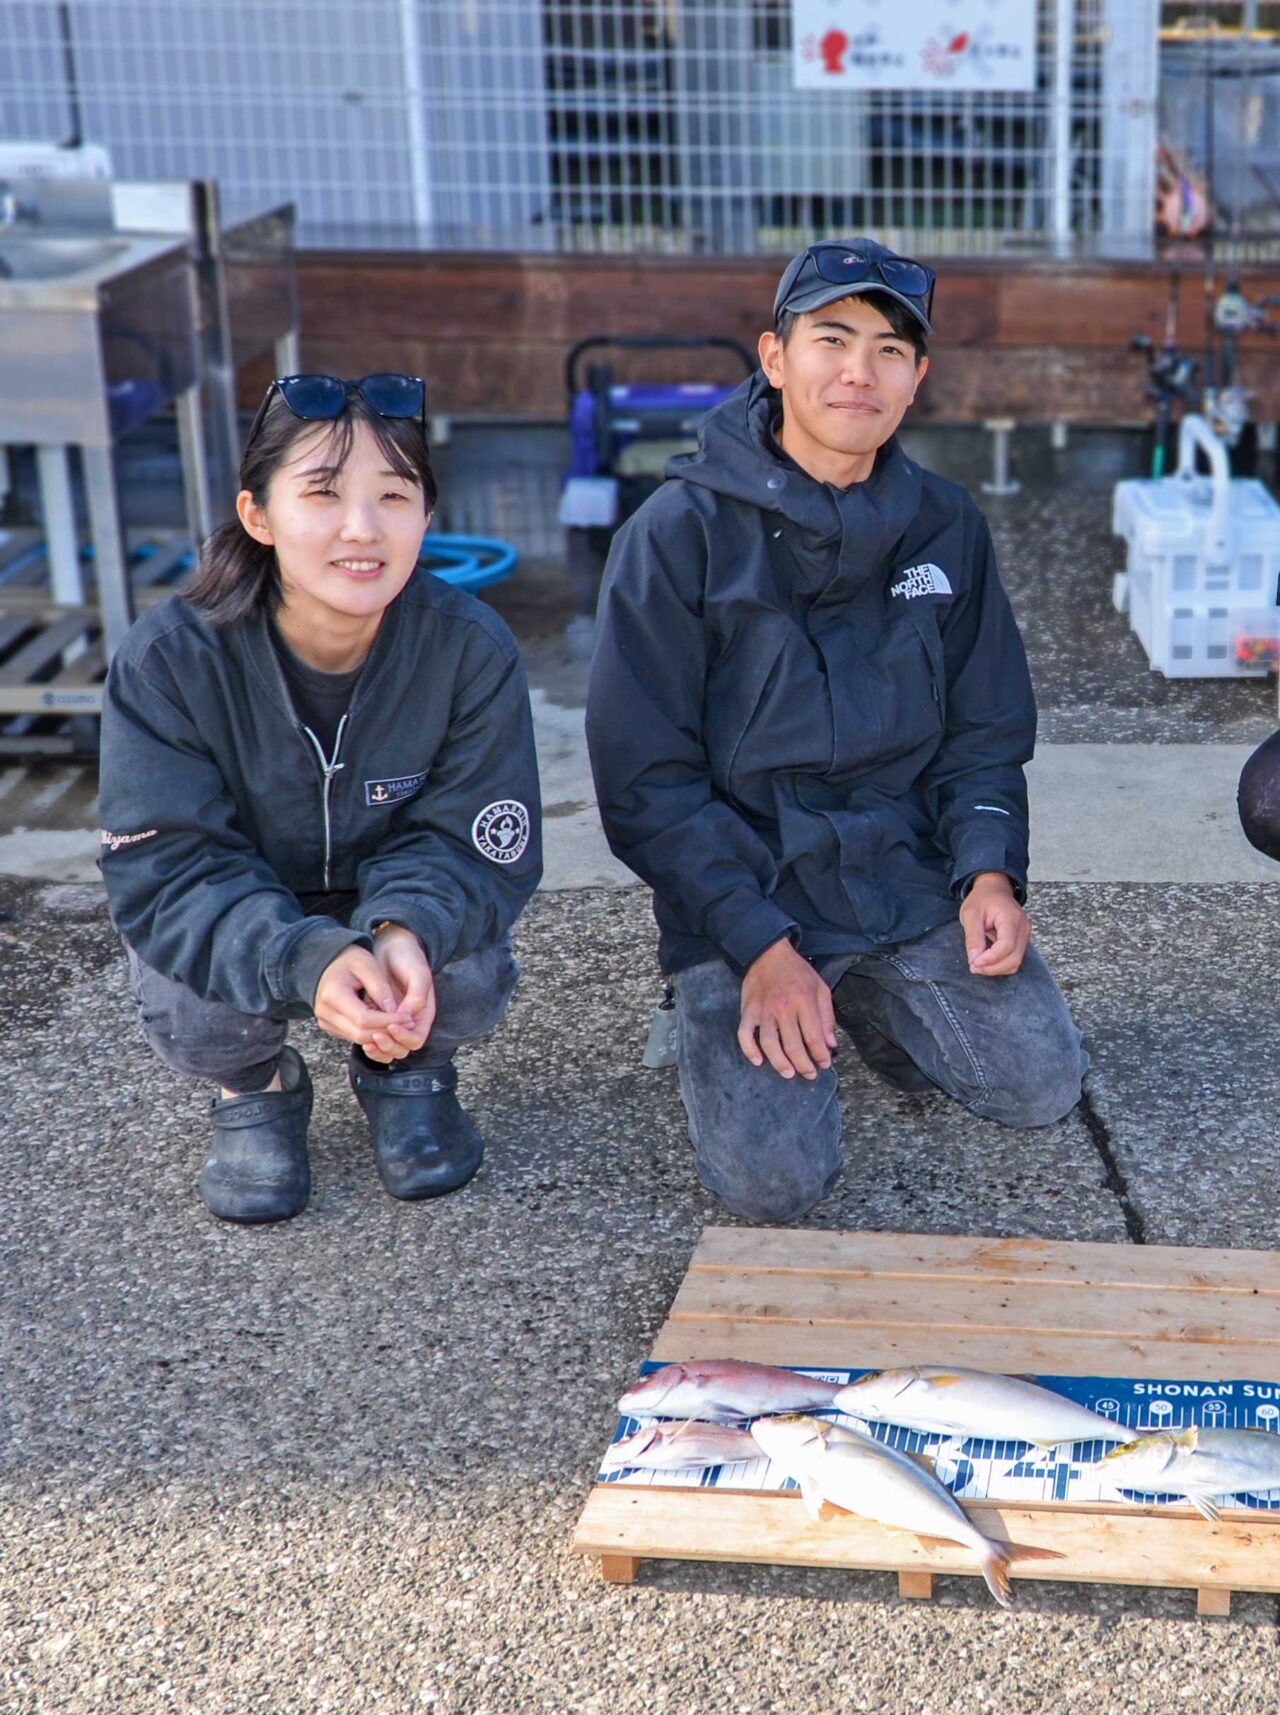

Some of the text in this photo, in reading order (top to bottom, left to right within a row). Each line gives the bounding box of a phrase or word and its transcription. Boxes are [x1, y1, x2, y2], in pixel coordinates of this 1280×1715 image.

[903, 563, 930, 579] THE
[890, 571, 934, 598] NORTH
[904, 583, 936, 600] FACE
[387, 775, 427, 792] HAMA
[1133, 1383, 1233, 1397] SHONAN
[1101, 1401, 1115, 1410] 45
[1155, 1402, 1168, 1412] 50
[1208, 1402, 1221, 1411] 55
[1261, 1407, 1274, 1416] 60
[1002, 1444, 1081, 1500] 4
